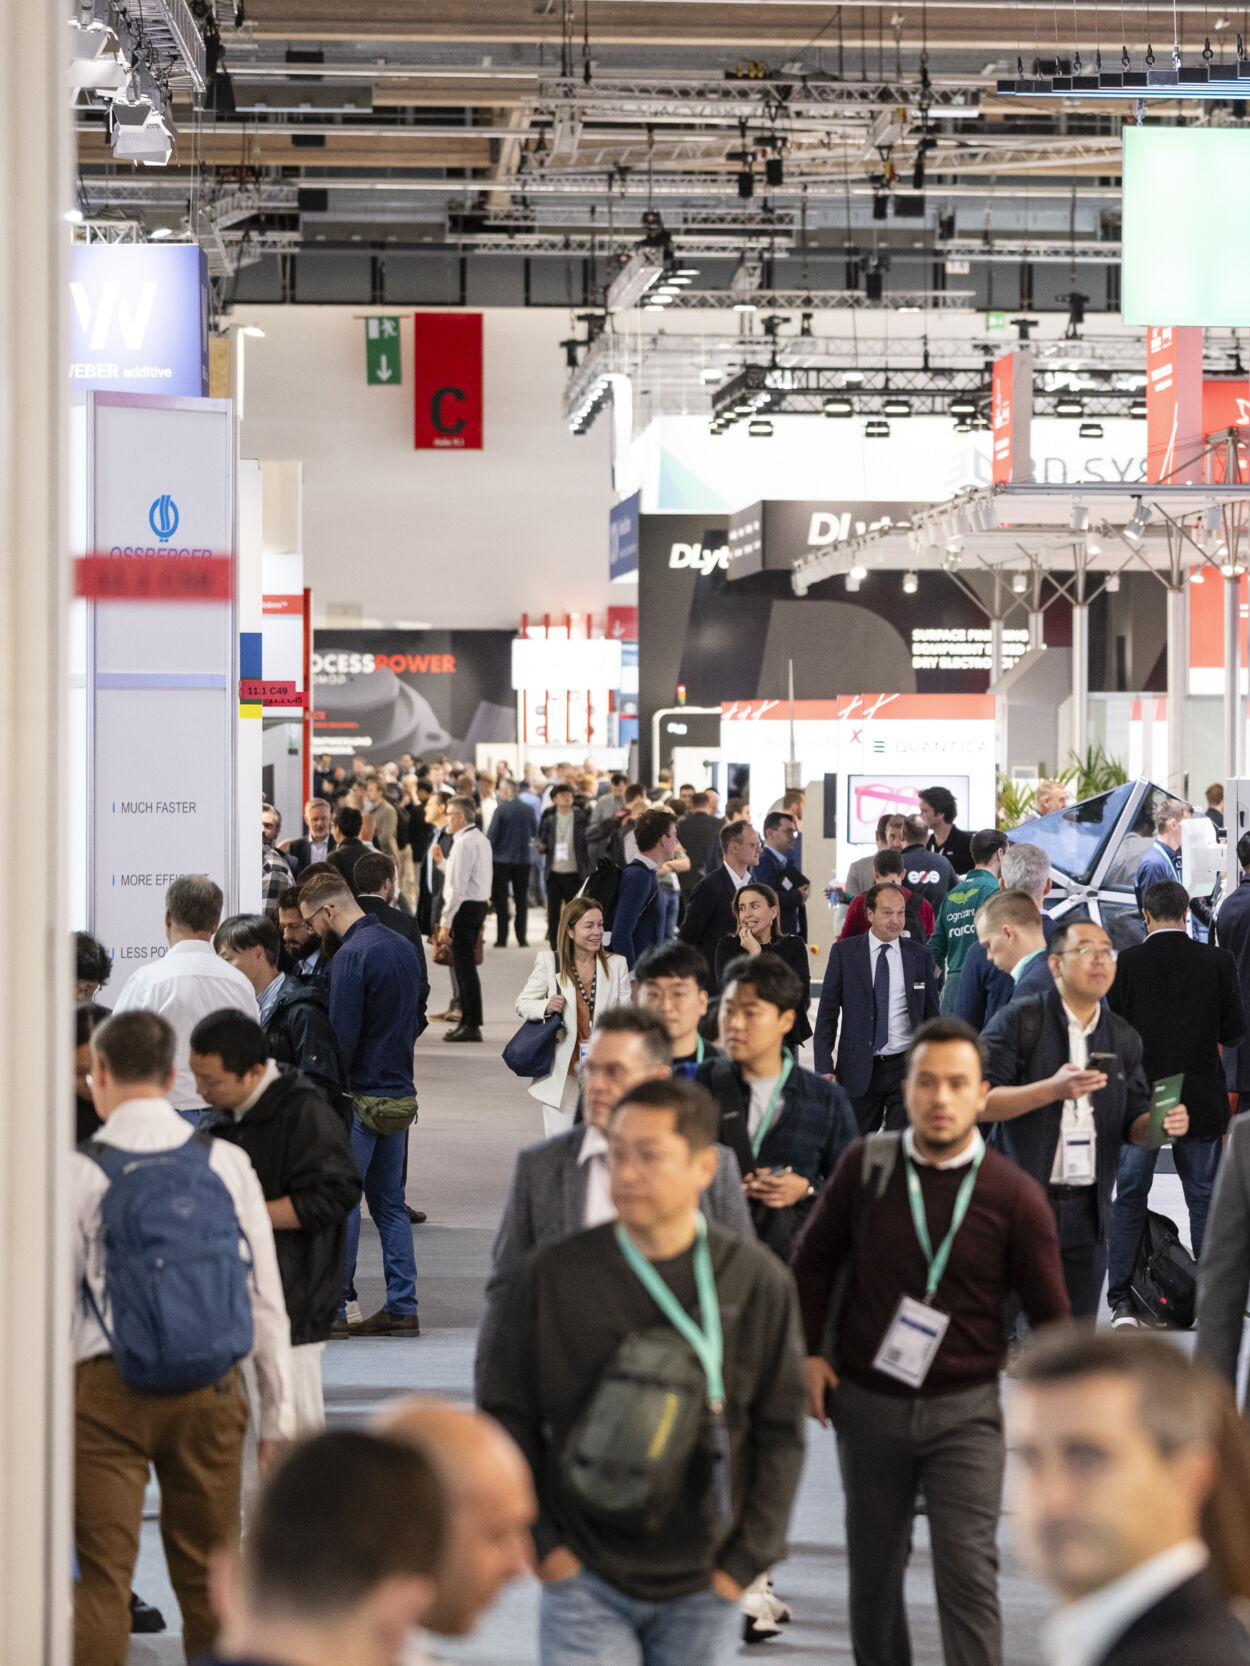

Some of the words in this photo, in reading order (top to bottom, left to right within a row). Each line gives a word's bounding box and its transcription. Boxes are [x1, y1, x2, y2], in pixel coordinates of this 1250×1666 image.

[70, 363, 119, 378] EBER
[124, 366, 173, 378] additive
[431, 386, 466, 434] C
[269, 687, 288, 695] C49
[121, 802, 153, 813] MUCH
[156, 802, 197, 813] FASTER
[121, 874, 152, 886] MORE
[120, 947, 147, 959] LESS
